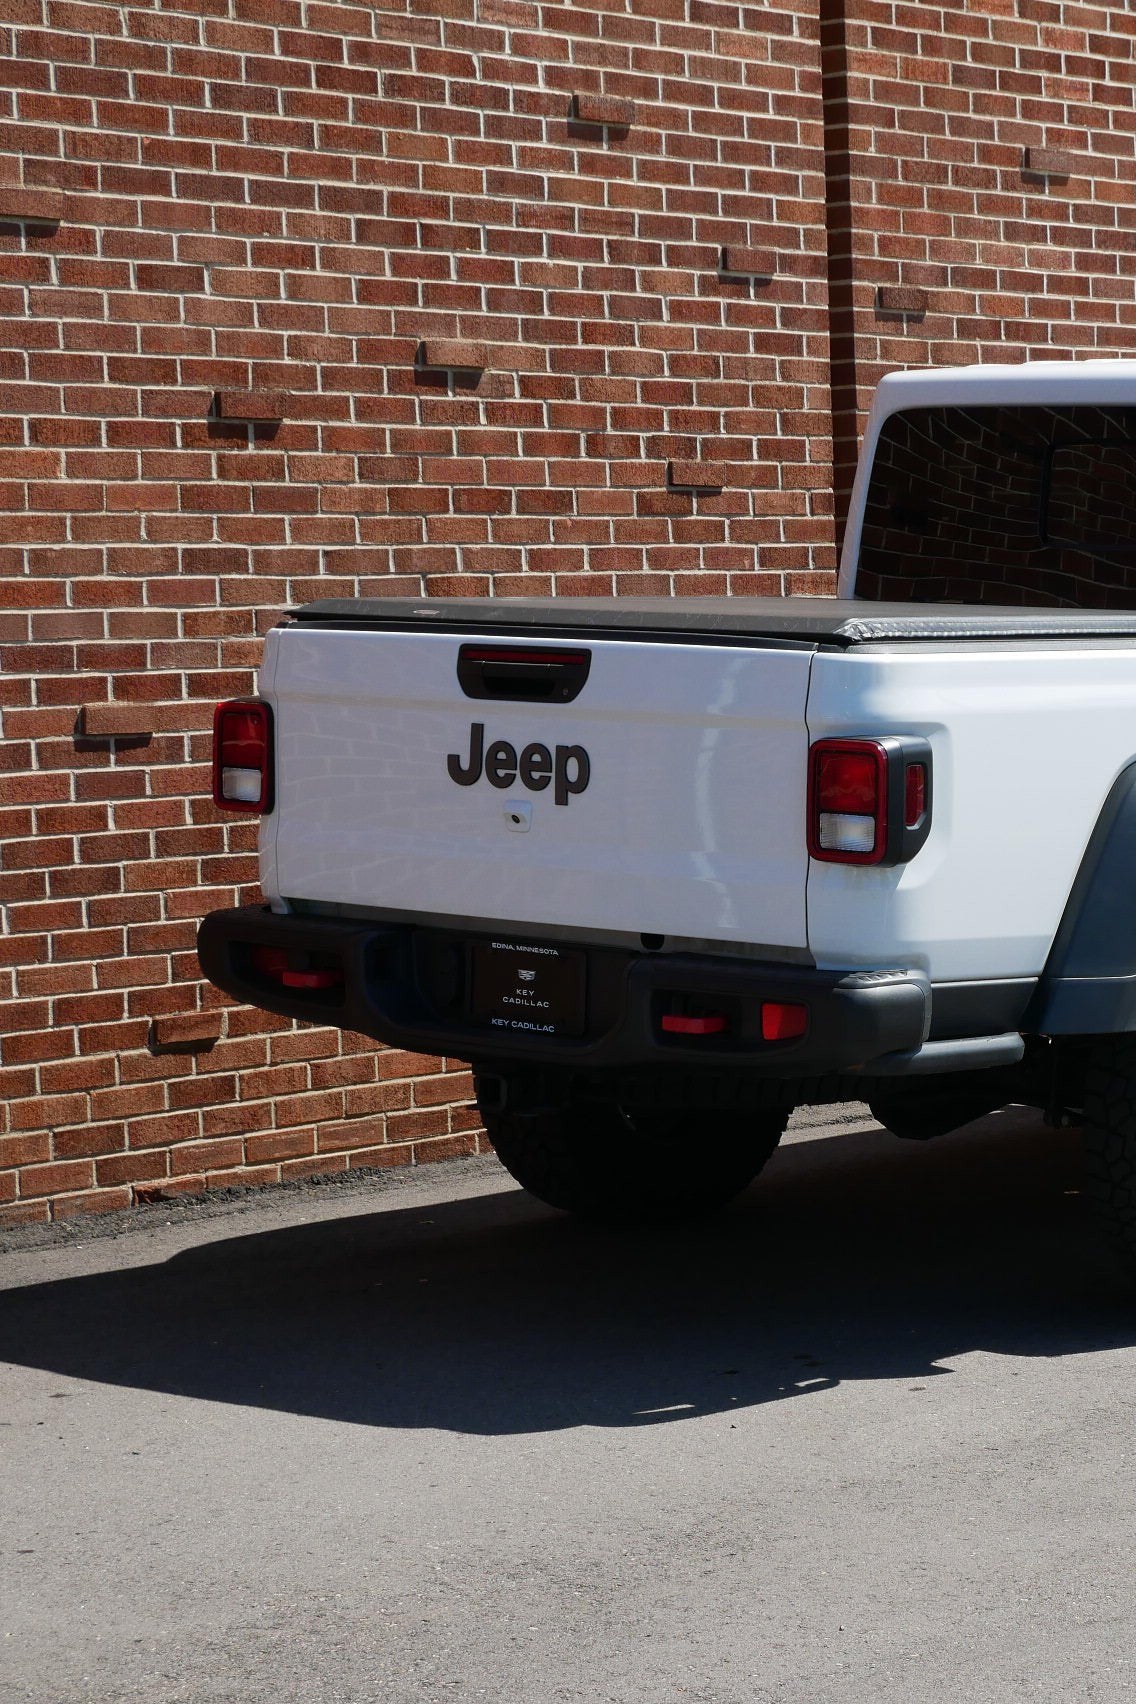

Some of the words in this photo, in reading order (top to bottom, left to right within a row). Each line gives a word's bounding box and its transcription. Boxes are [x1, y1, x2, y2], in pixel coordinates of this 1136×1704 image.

[447, 722, 591, 806] Jeep
[516, 945, 559, 956] MINNESOTA
[516, 988, 535, 997] KEY
[502, 996, 550, 1008] CADILLAC
[491, 1018, 509, 1027] KEY
[511, 1020, 555, 1033] CADILLAC
